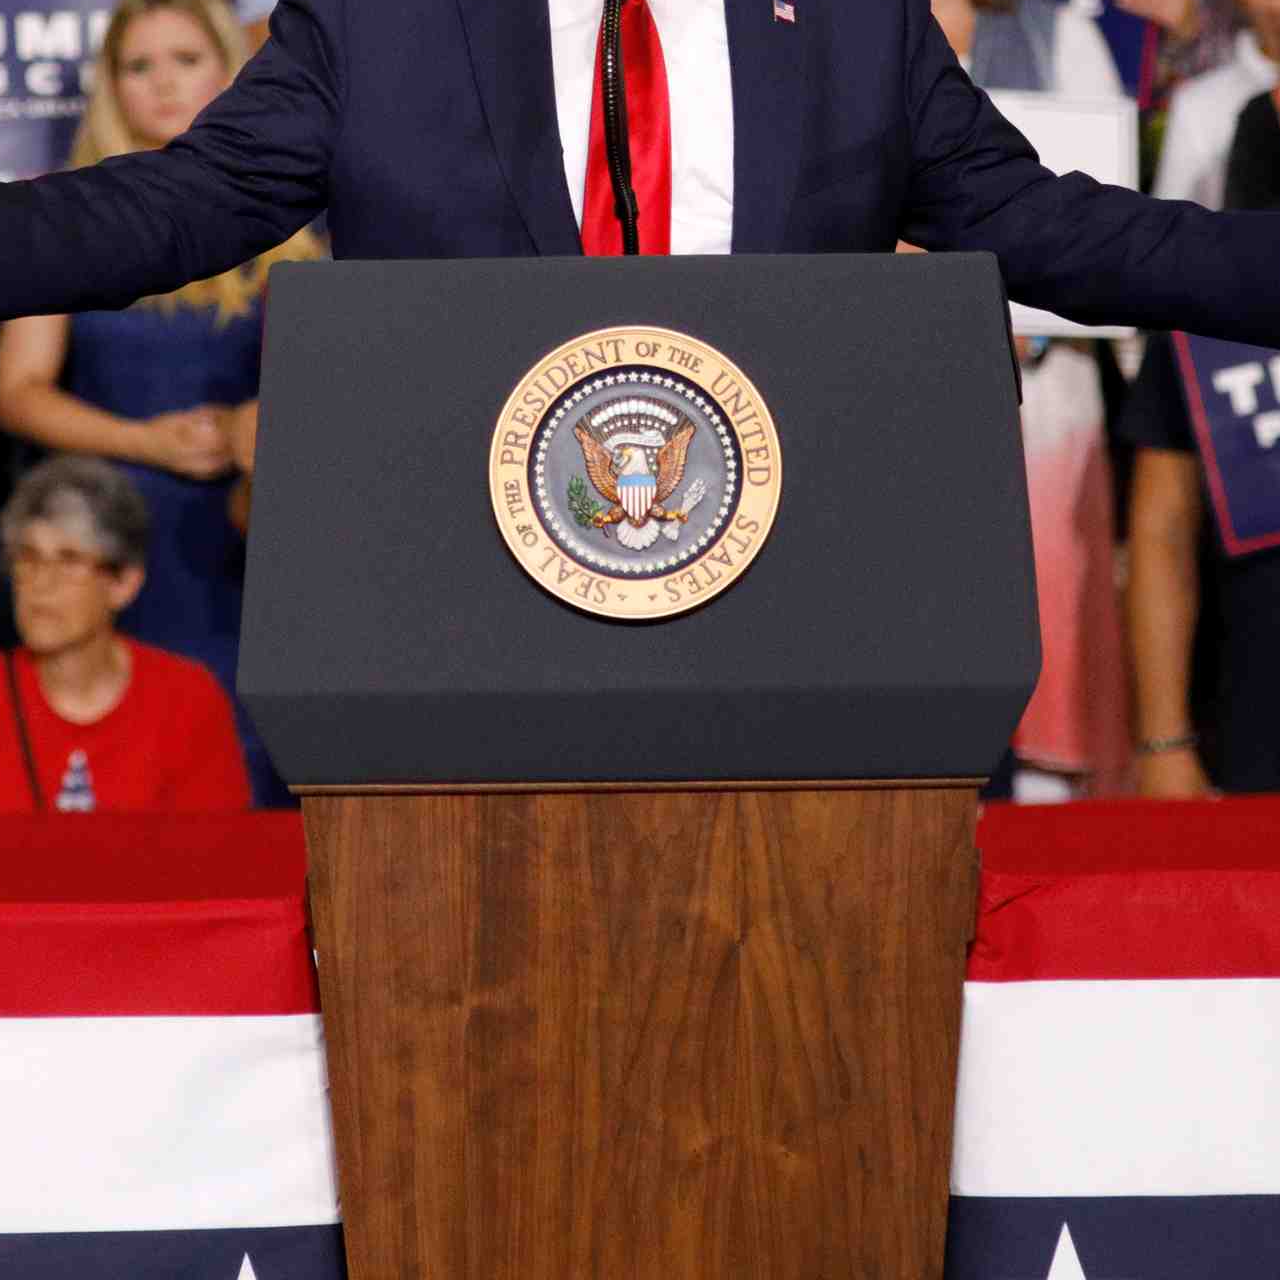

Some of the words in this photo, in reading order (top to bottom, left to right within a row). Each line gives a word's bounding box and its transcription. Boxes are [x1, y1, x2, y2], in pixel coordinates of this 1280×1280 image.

[634, 341, 661, 359] OF
[667, 345, 705, 374] THE
[500, 338, 626, 468] PRESIDENT
[710, 370, 772, 487] UNITED
[503, 479, 521, 519] THE
[516, 522, 539, 548] OF
[662, 513, 760, 603] STATES
[537, 546, 611, 605] SEAL
